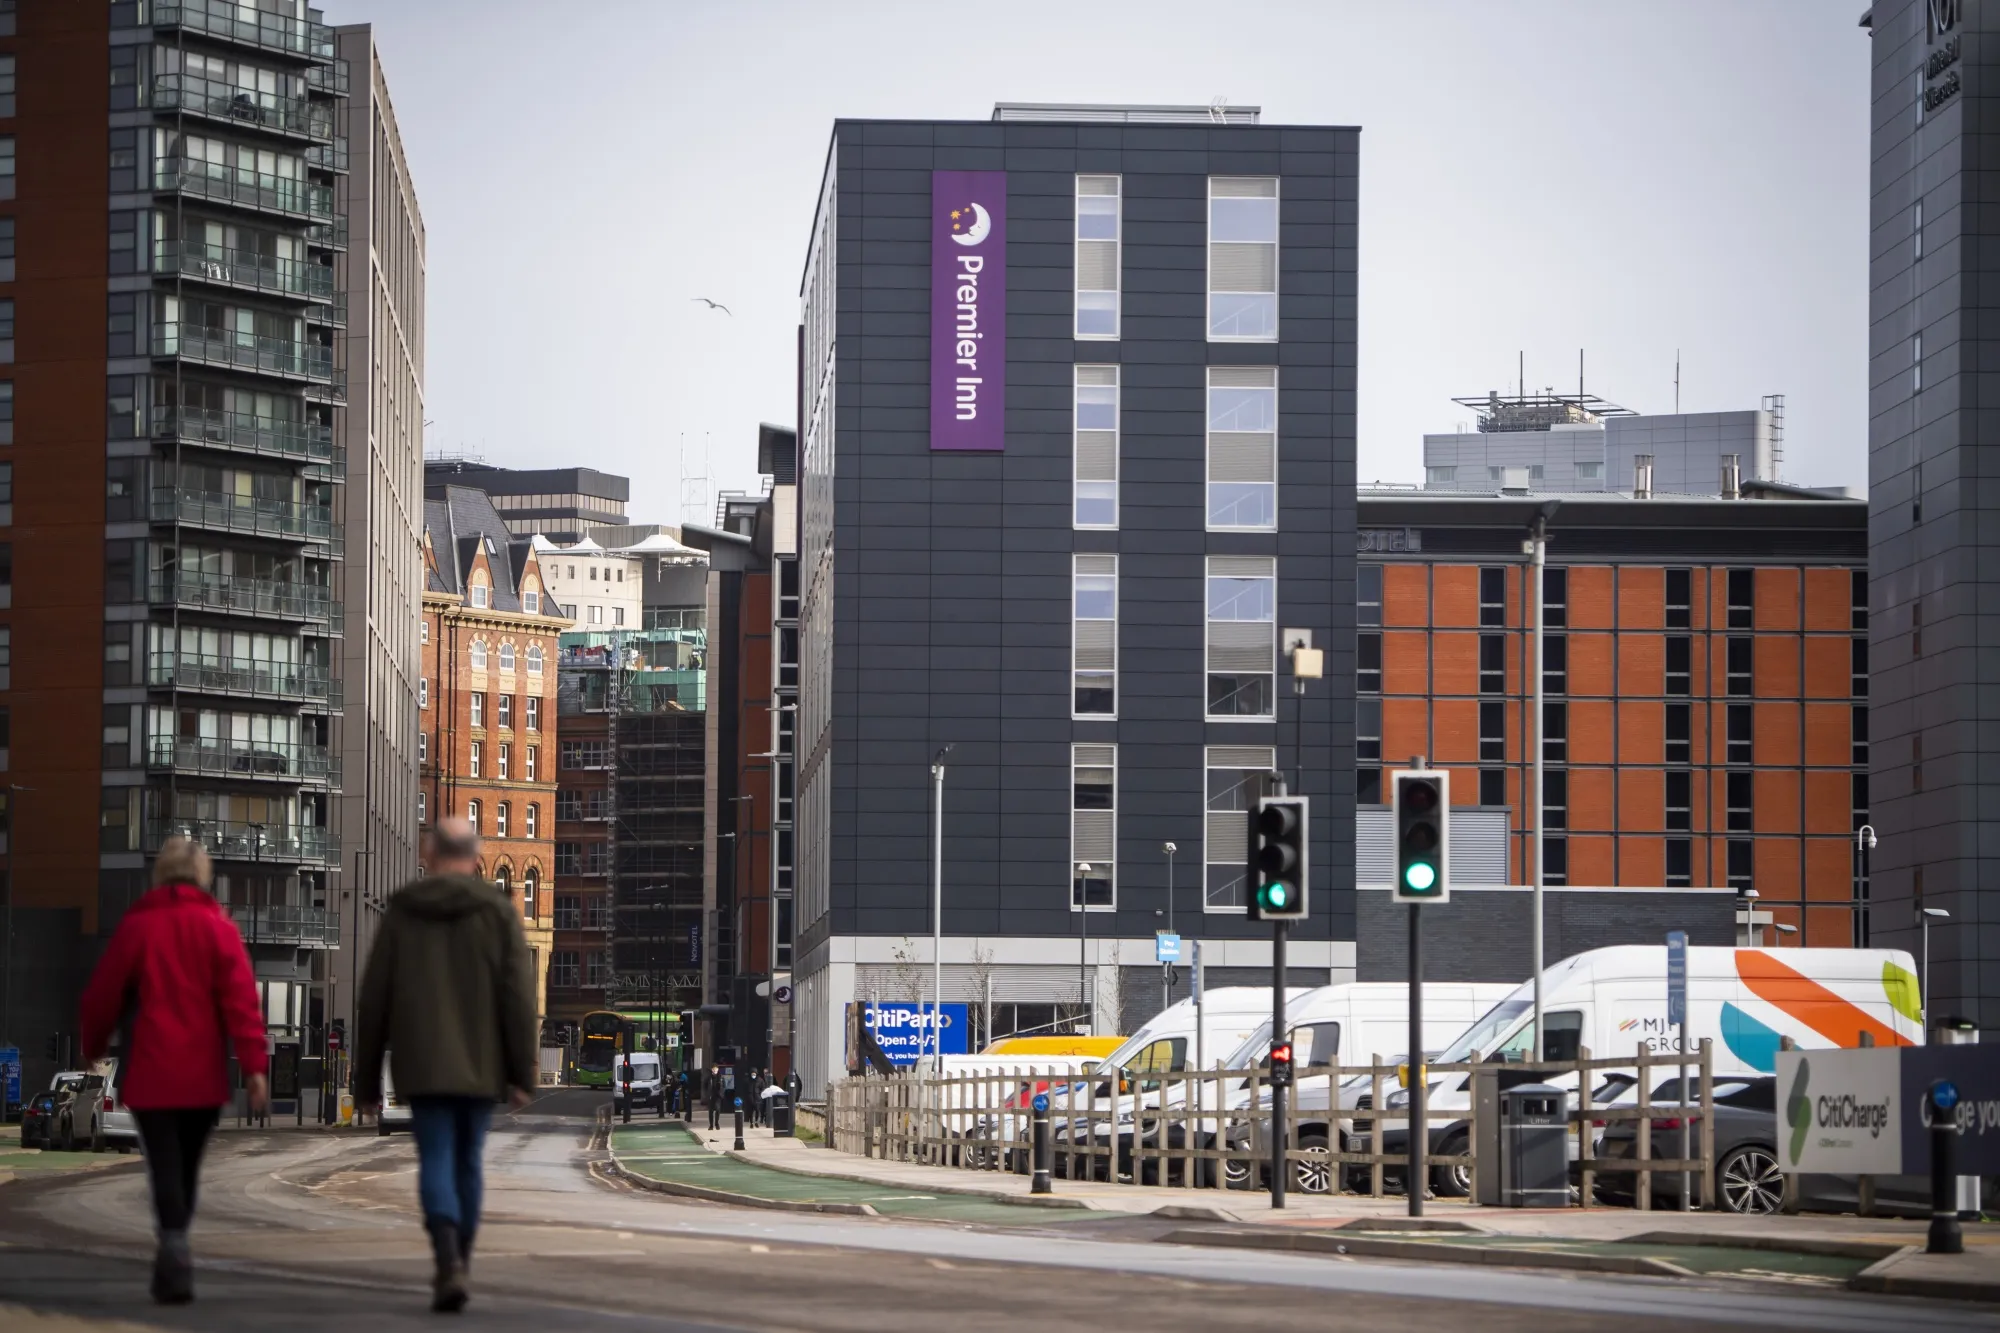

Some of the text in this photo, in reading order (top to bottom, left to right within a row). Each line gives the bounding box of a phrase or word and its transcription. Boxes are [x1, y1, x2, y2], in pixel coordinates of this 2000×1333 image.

[956, 256, 983, 420] Premier Inn
[1357, 527, 1421, 552] OTEL
[864, 1009, 944, 1028] CitiPark
[876, 1034, 907, 1047] Open
[1645, 1037, 1713, 1051] GROU
[908, 1052, 921, 1060] hav
[1818, 1094, 1888, 1139] CitiCharge
[1978, 1101, 2000, 1135] yo
